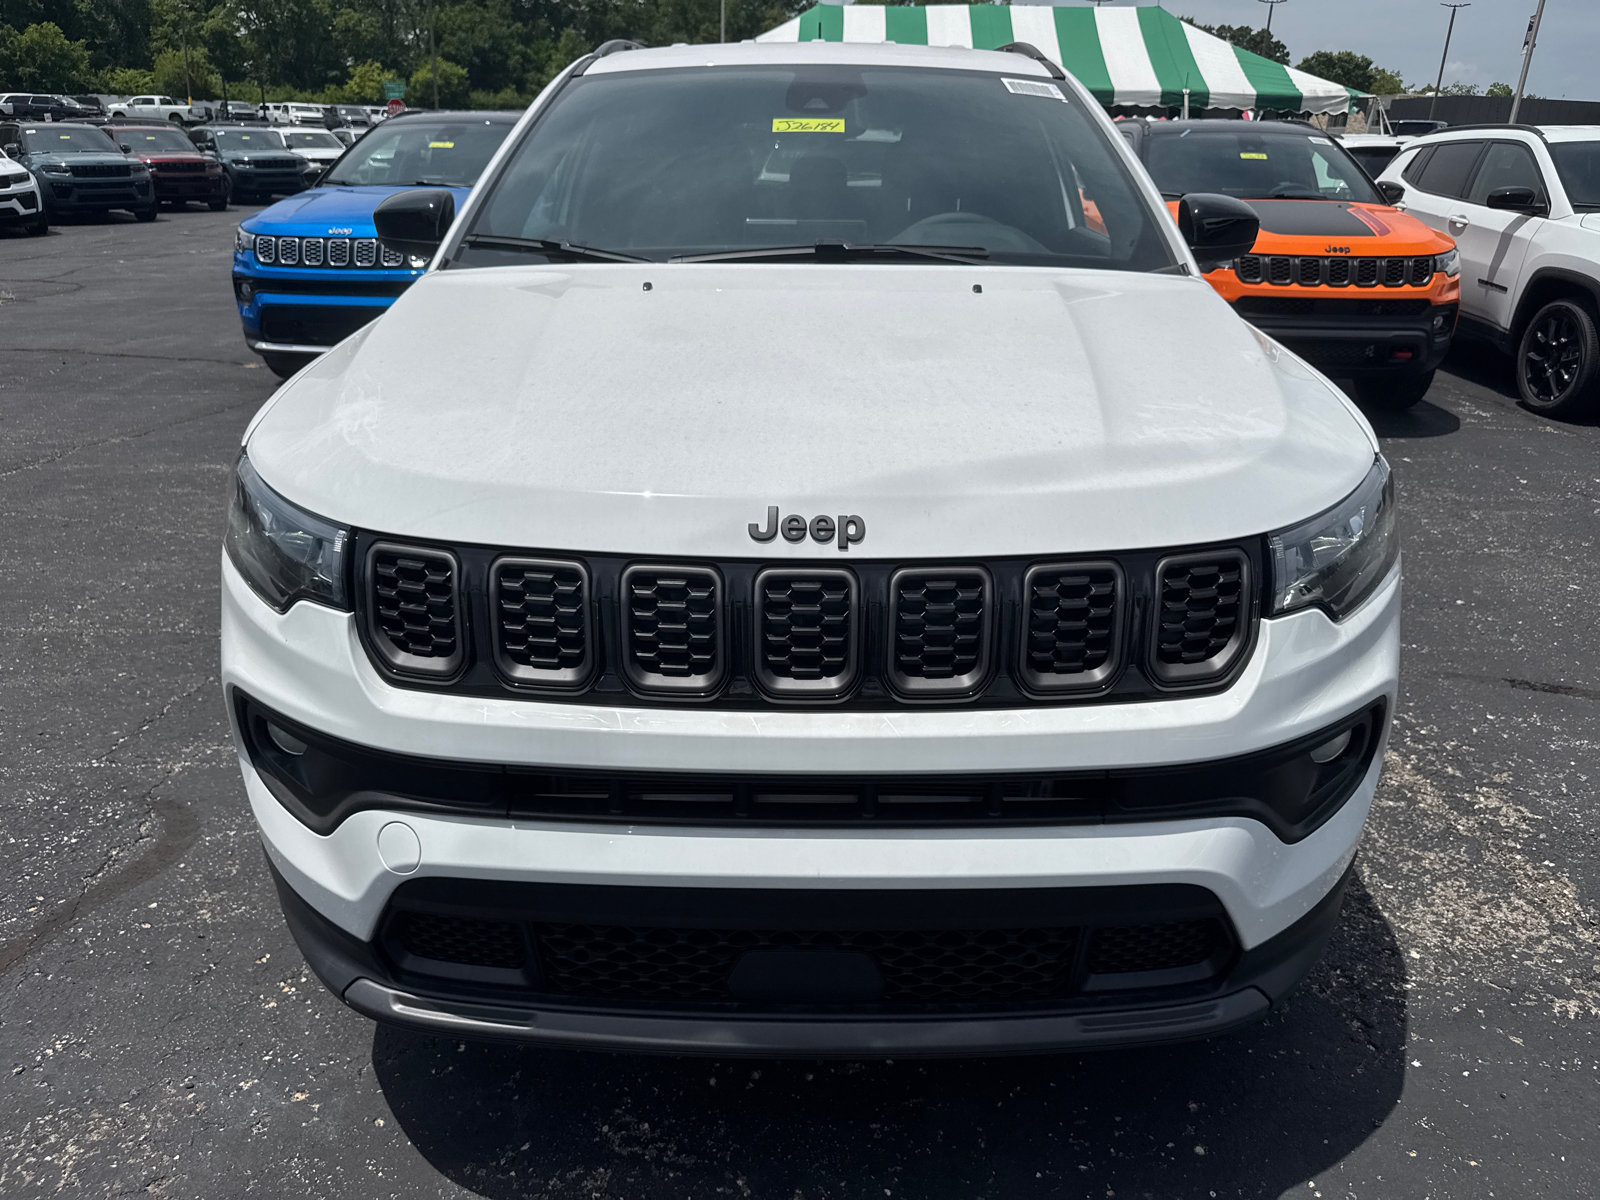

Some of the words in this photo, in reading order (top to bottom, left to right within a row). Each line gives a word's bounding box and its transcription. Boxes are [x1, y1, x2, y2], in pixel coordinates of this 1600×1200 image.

[328, 227, 353, 236] Jeep
[1324, 245, 1351, 255] Jeep
[748, 505, 866, 550] Jeep
